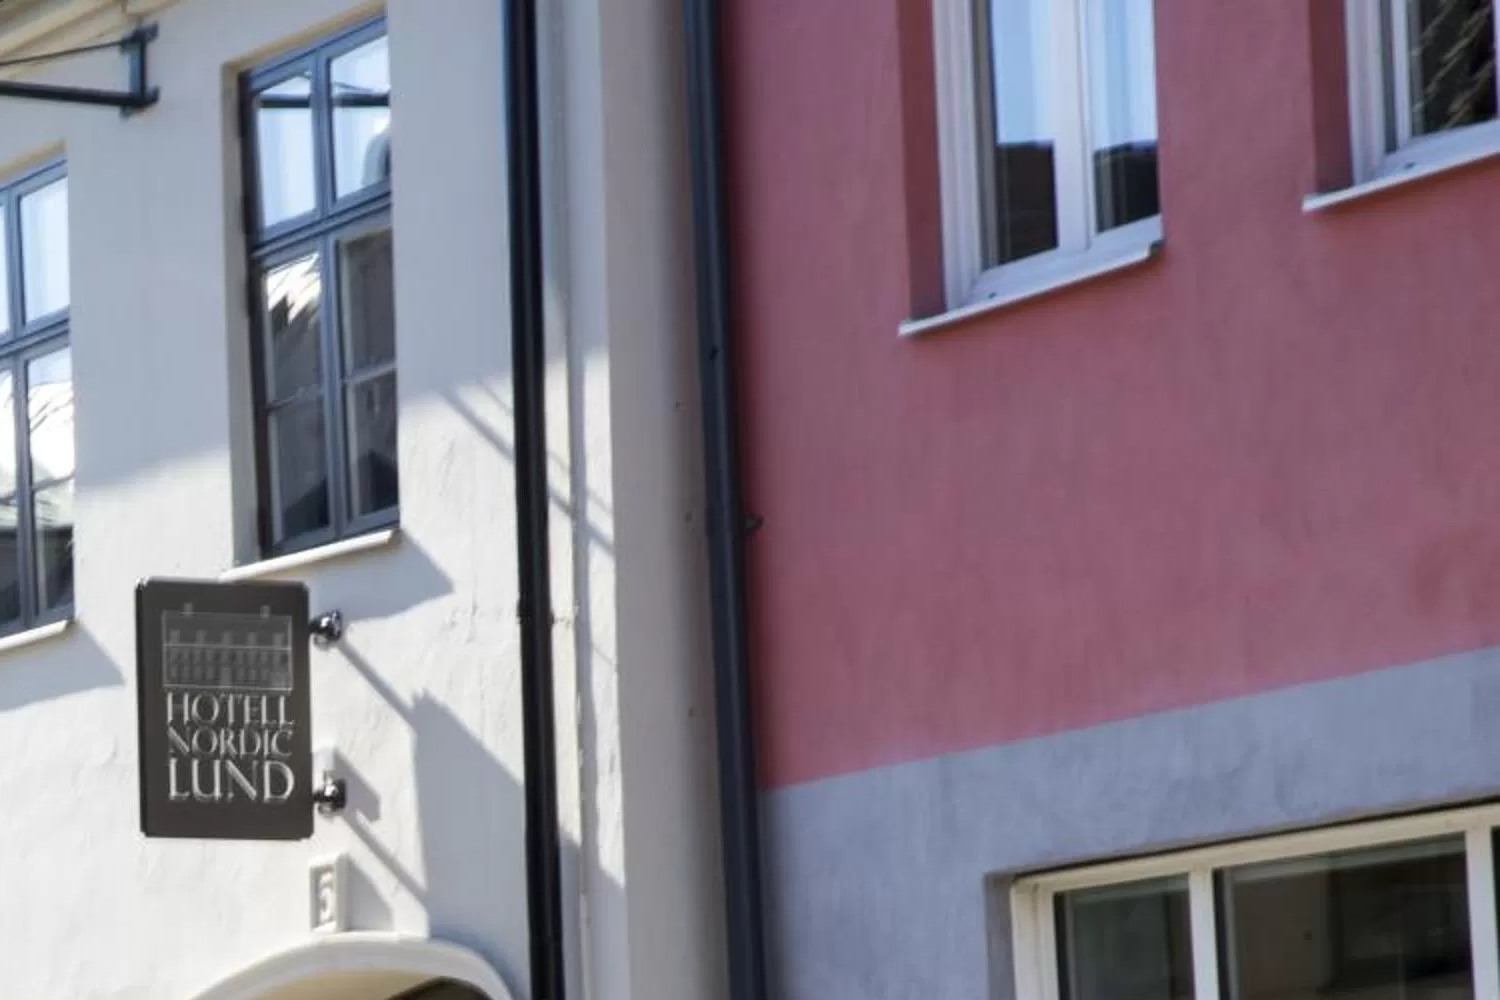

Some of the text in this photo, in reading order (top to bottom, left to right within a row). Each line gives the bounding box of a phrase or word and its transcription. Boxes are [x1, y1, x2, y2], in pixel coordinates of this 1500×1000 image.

[166, 691, 294, 726] HOTELL
[169, 726, 293, 757] NORDIC
[169, 759, 295, 801] LUND
